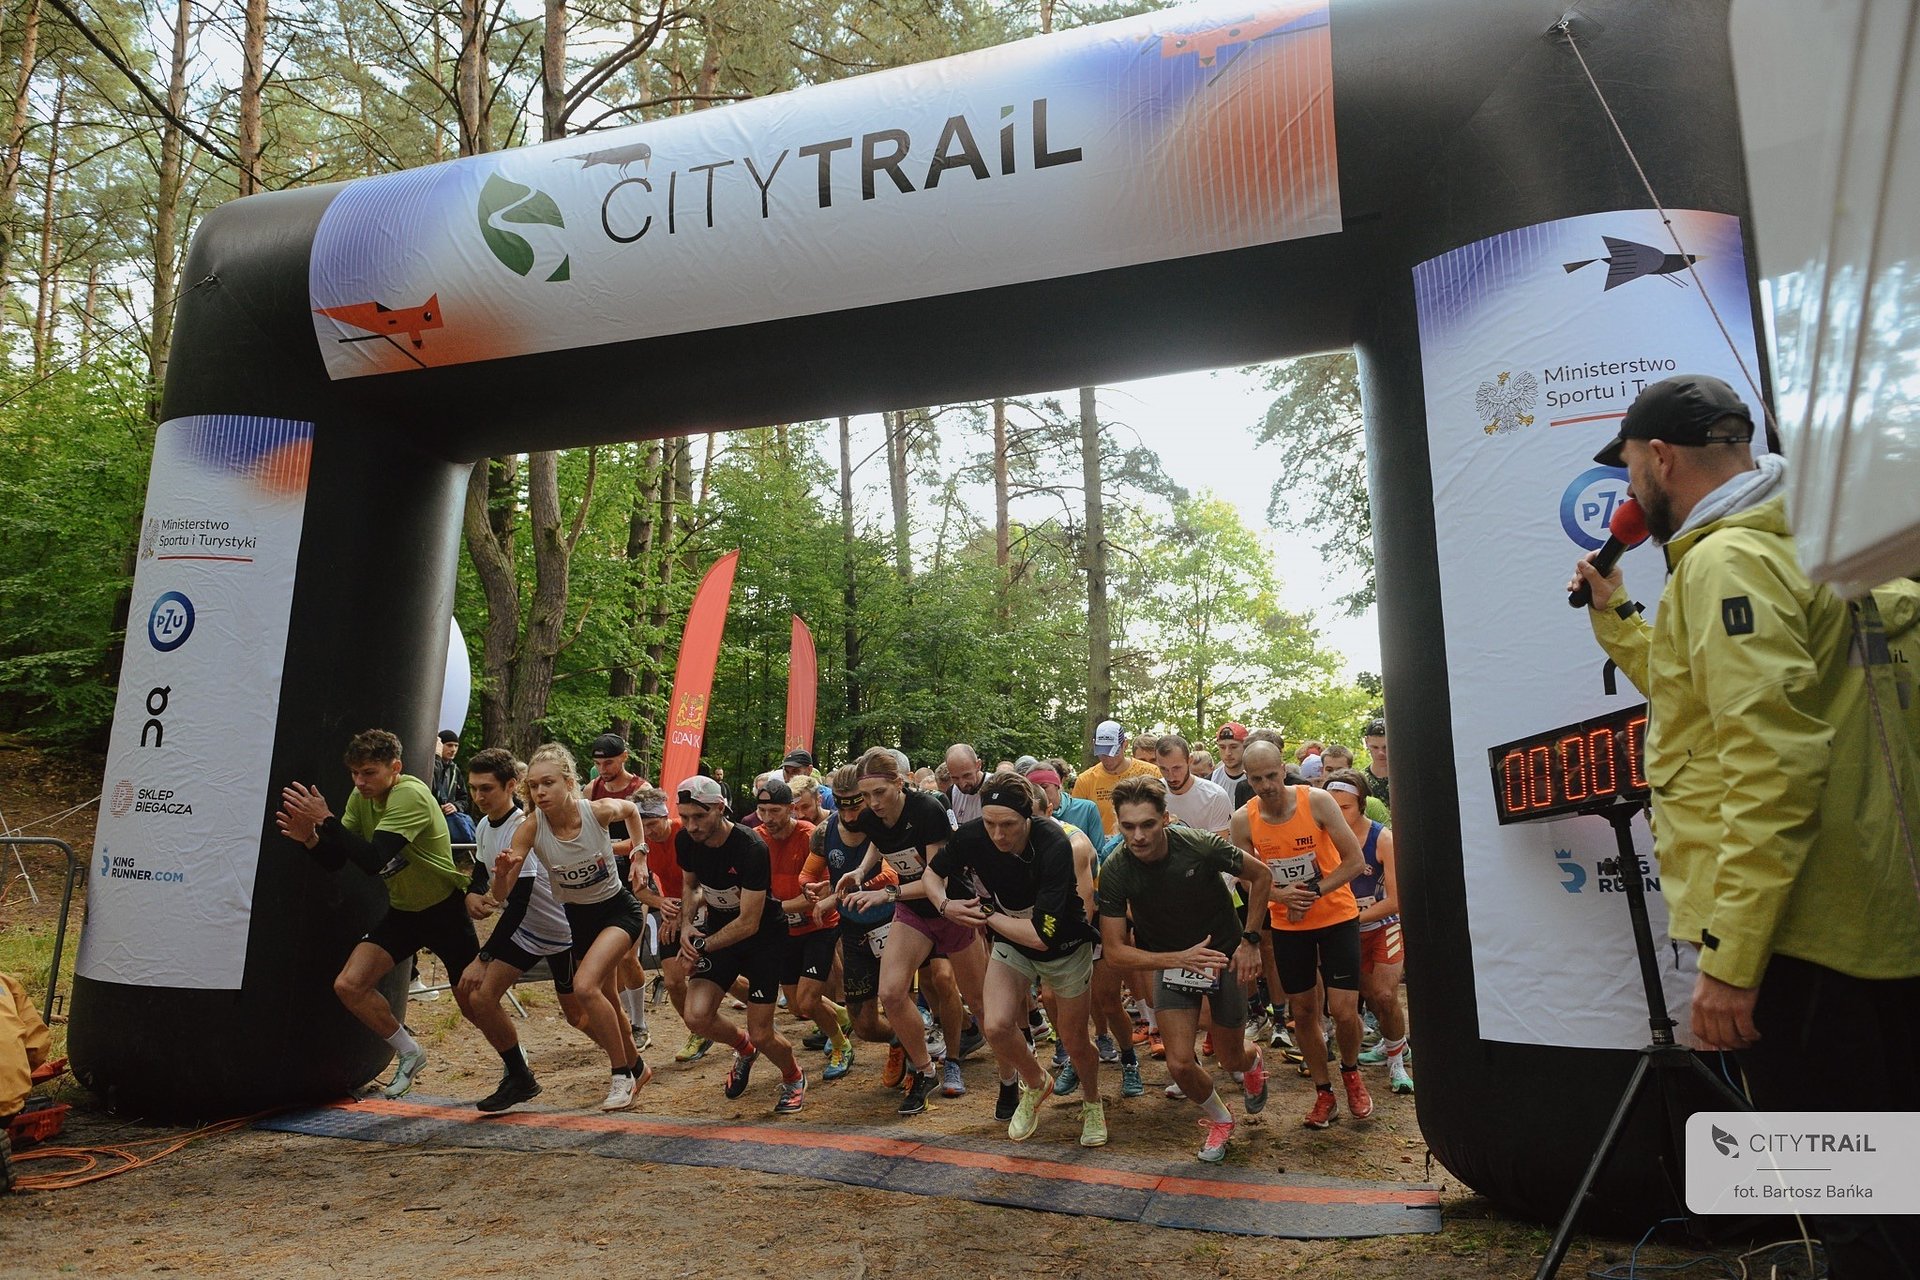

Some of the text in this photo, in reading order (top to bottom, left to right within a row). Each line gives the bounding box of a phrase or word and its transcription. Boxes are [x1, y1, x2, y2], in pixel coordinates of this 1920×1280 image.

[1544, 357, 1676, 384] Ministerstwo
[1546, 381, 1614, 408] Sportu
[1621, 382, 1626, 397] i
[161, 518, 229, 531] Ministerstwo
[159, 535, 189, 547] Sportu
[199, 534, 256, 549] Turystyki
[157, 609, 183, 634] PZU
[138, 789, 174, 800] SKLEP
[135, 802, 193, 815] BIEGACZA
[113, 857, 135, 867] KING
[894, 861, 911, 870] 12
[111, 869, 183, 883] RUNNER.COM
[560, 864, 597, 880] 1059
[1281, 865, 1305, 878] 157
